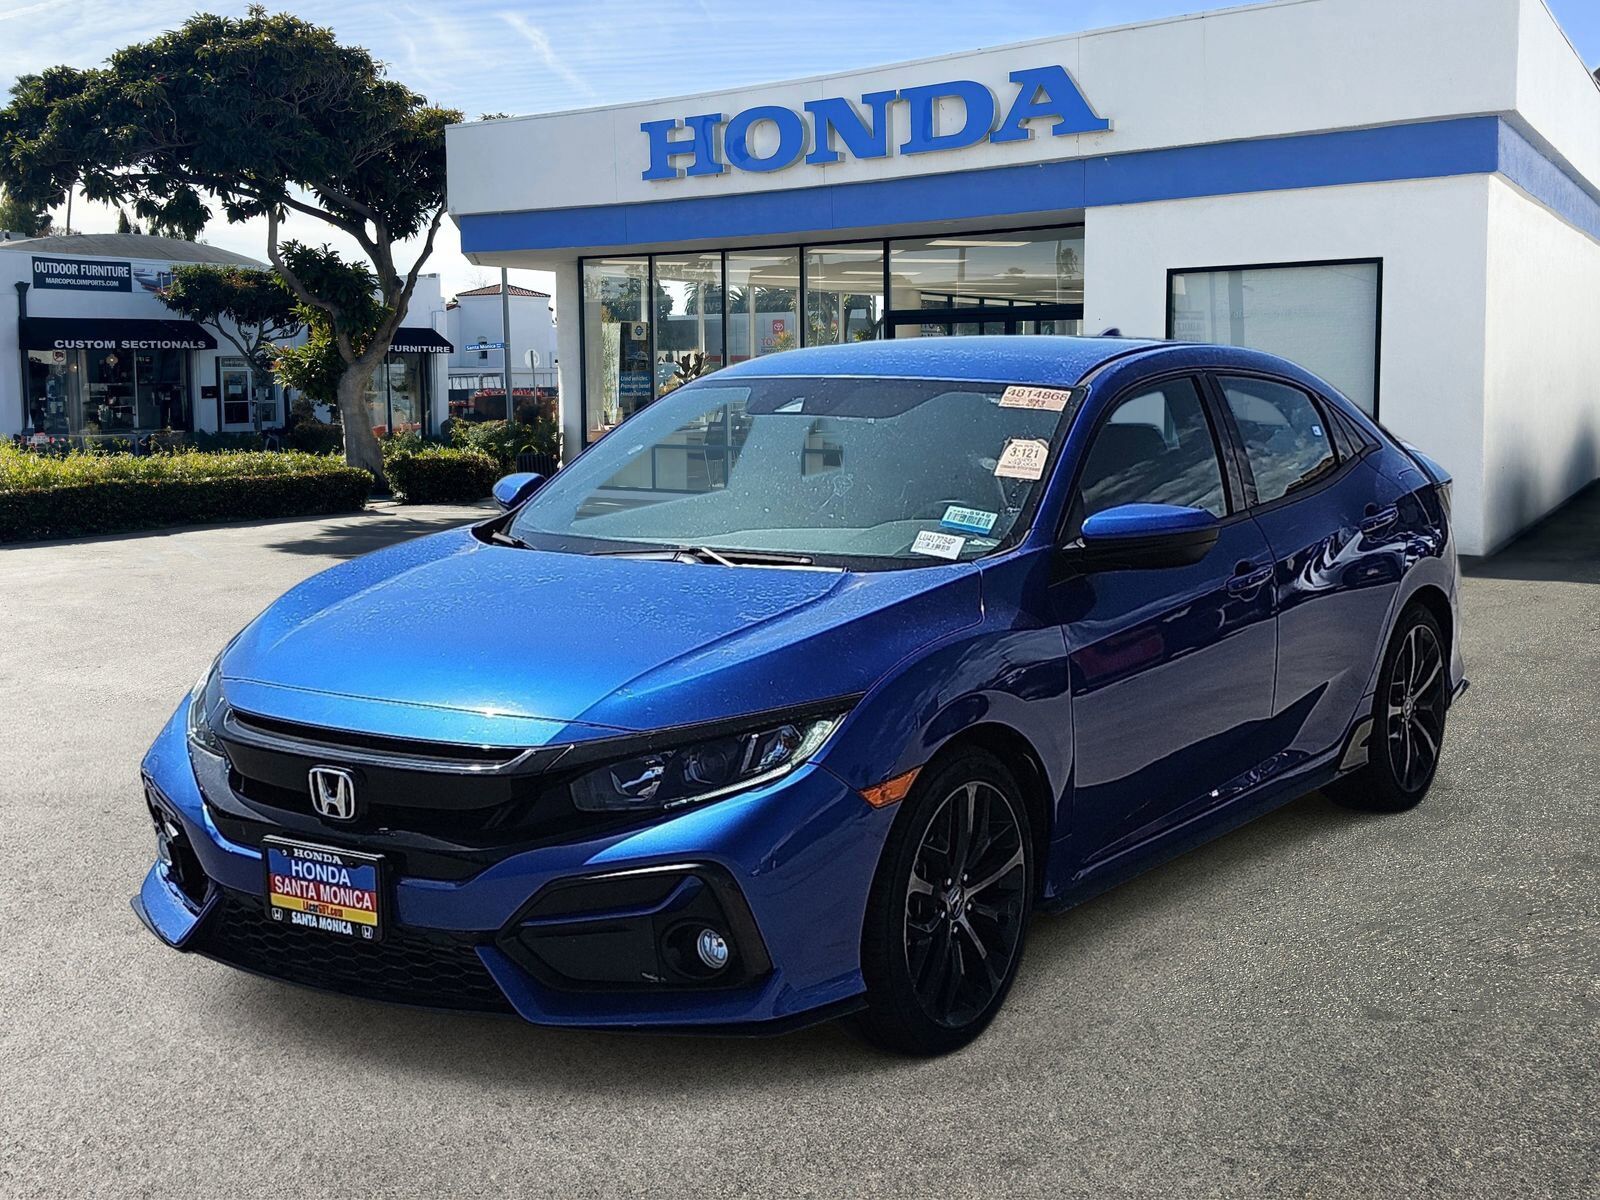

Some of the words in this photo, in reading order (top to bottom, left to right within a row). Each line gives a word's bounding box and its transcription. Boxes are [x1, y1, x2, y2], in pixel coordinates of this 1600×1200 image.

[639, 65, 1112, 181] HONDA
[34, 261, 78, 275] OUTDOOR
[81, 265, 130, 278] FURNITURE
[45, 277, 119, 287] MARCOPOLOIMPORTS.COM
[54, 339, 116, 349] CUSTOM
[121, 340, 206, 349] SECTIONALS
[388, 344, 450, 353] FURNITURE
[293, 848, 344, 866] HONDA
[291, 859, 352, 887] HONDA
[274, 875, 318, 900] SANTA
[320, 883, 373, 911] MONICA
[291, 911, 318, 928] SANTA
[318, 917, 353, 935] MONICA
